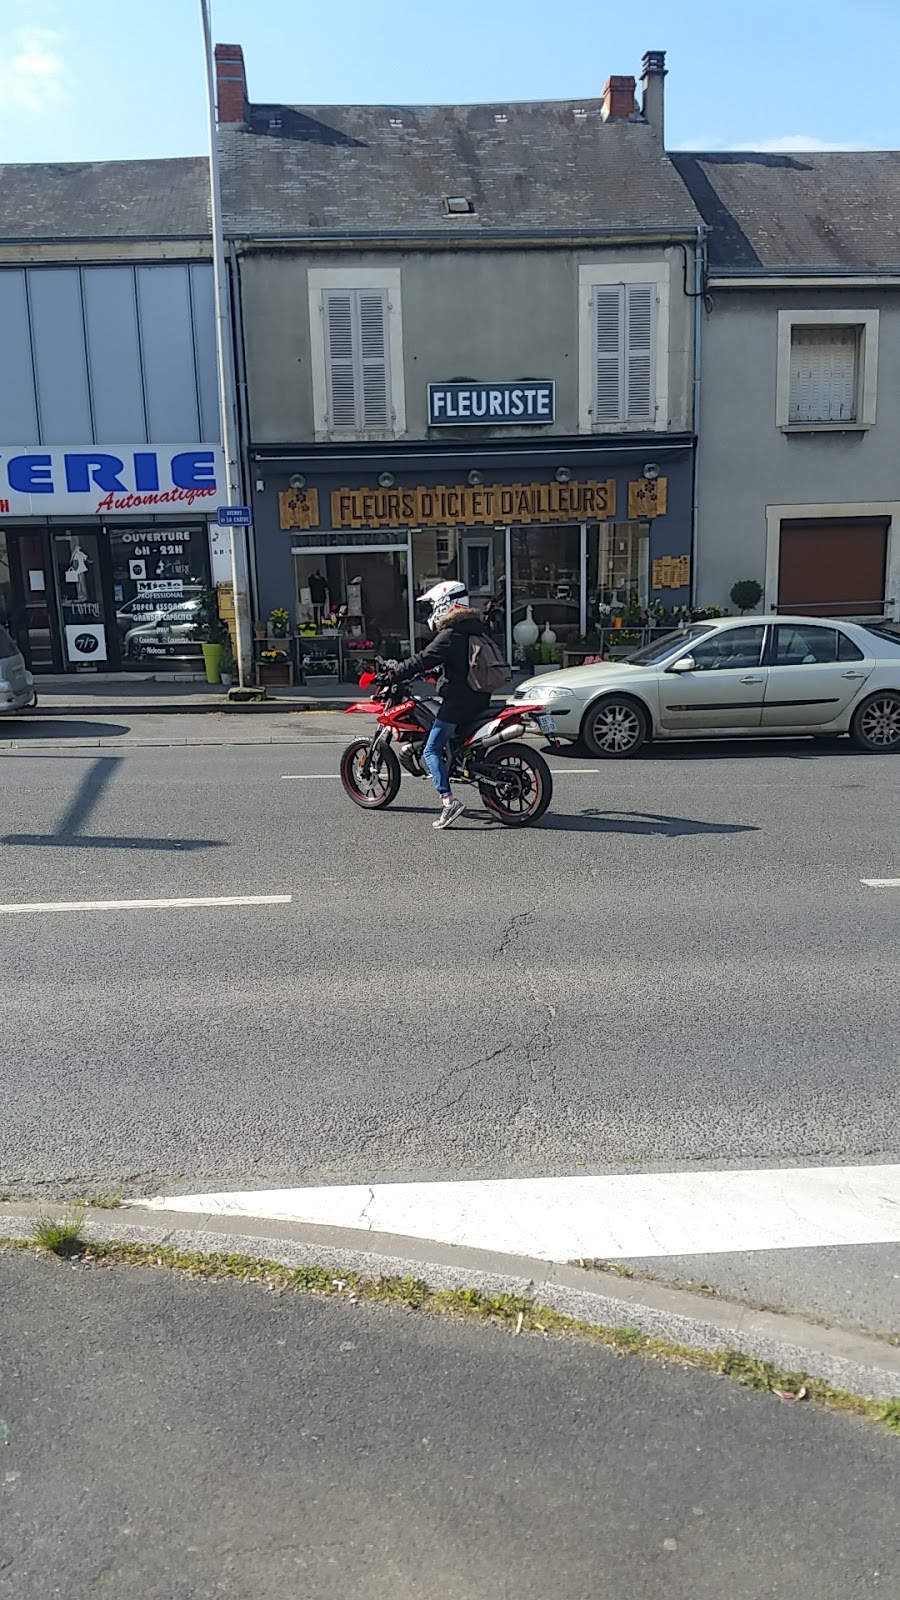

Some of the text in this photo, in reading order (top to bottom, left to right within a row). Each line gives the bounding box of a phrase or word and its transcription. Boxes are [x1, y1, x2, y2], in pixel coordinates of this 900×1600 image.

[433, 389, 550, 417] FLEURISTE
[0, 451, 217, 494] ERIE
[96, 486, 217, 513] Automatique
[340, 486, 609, 521] FLEURS D'ICI ET D'AILLEURS
[122, 531, 191, 543] OUVERTURE
[134, 546, 151, 556] 6H
[159, 545, 184, 555] 22H
[139, 581, 182, 591] Miele
[131, 603, 154, 611] SUPER
[132, 613, 161, 622] GRANDES
[77, 636, 96, 649] 7/7
